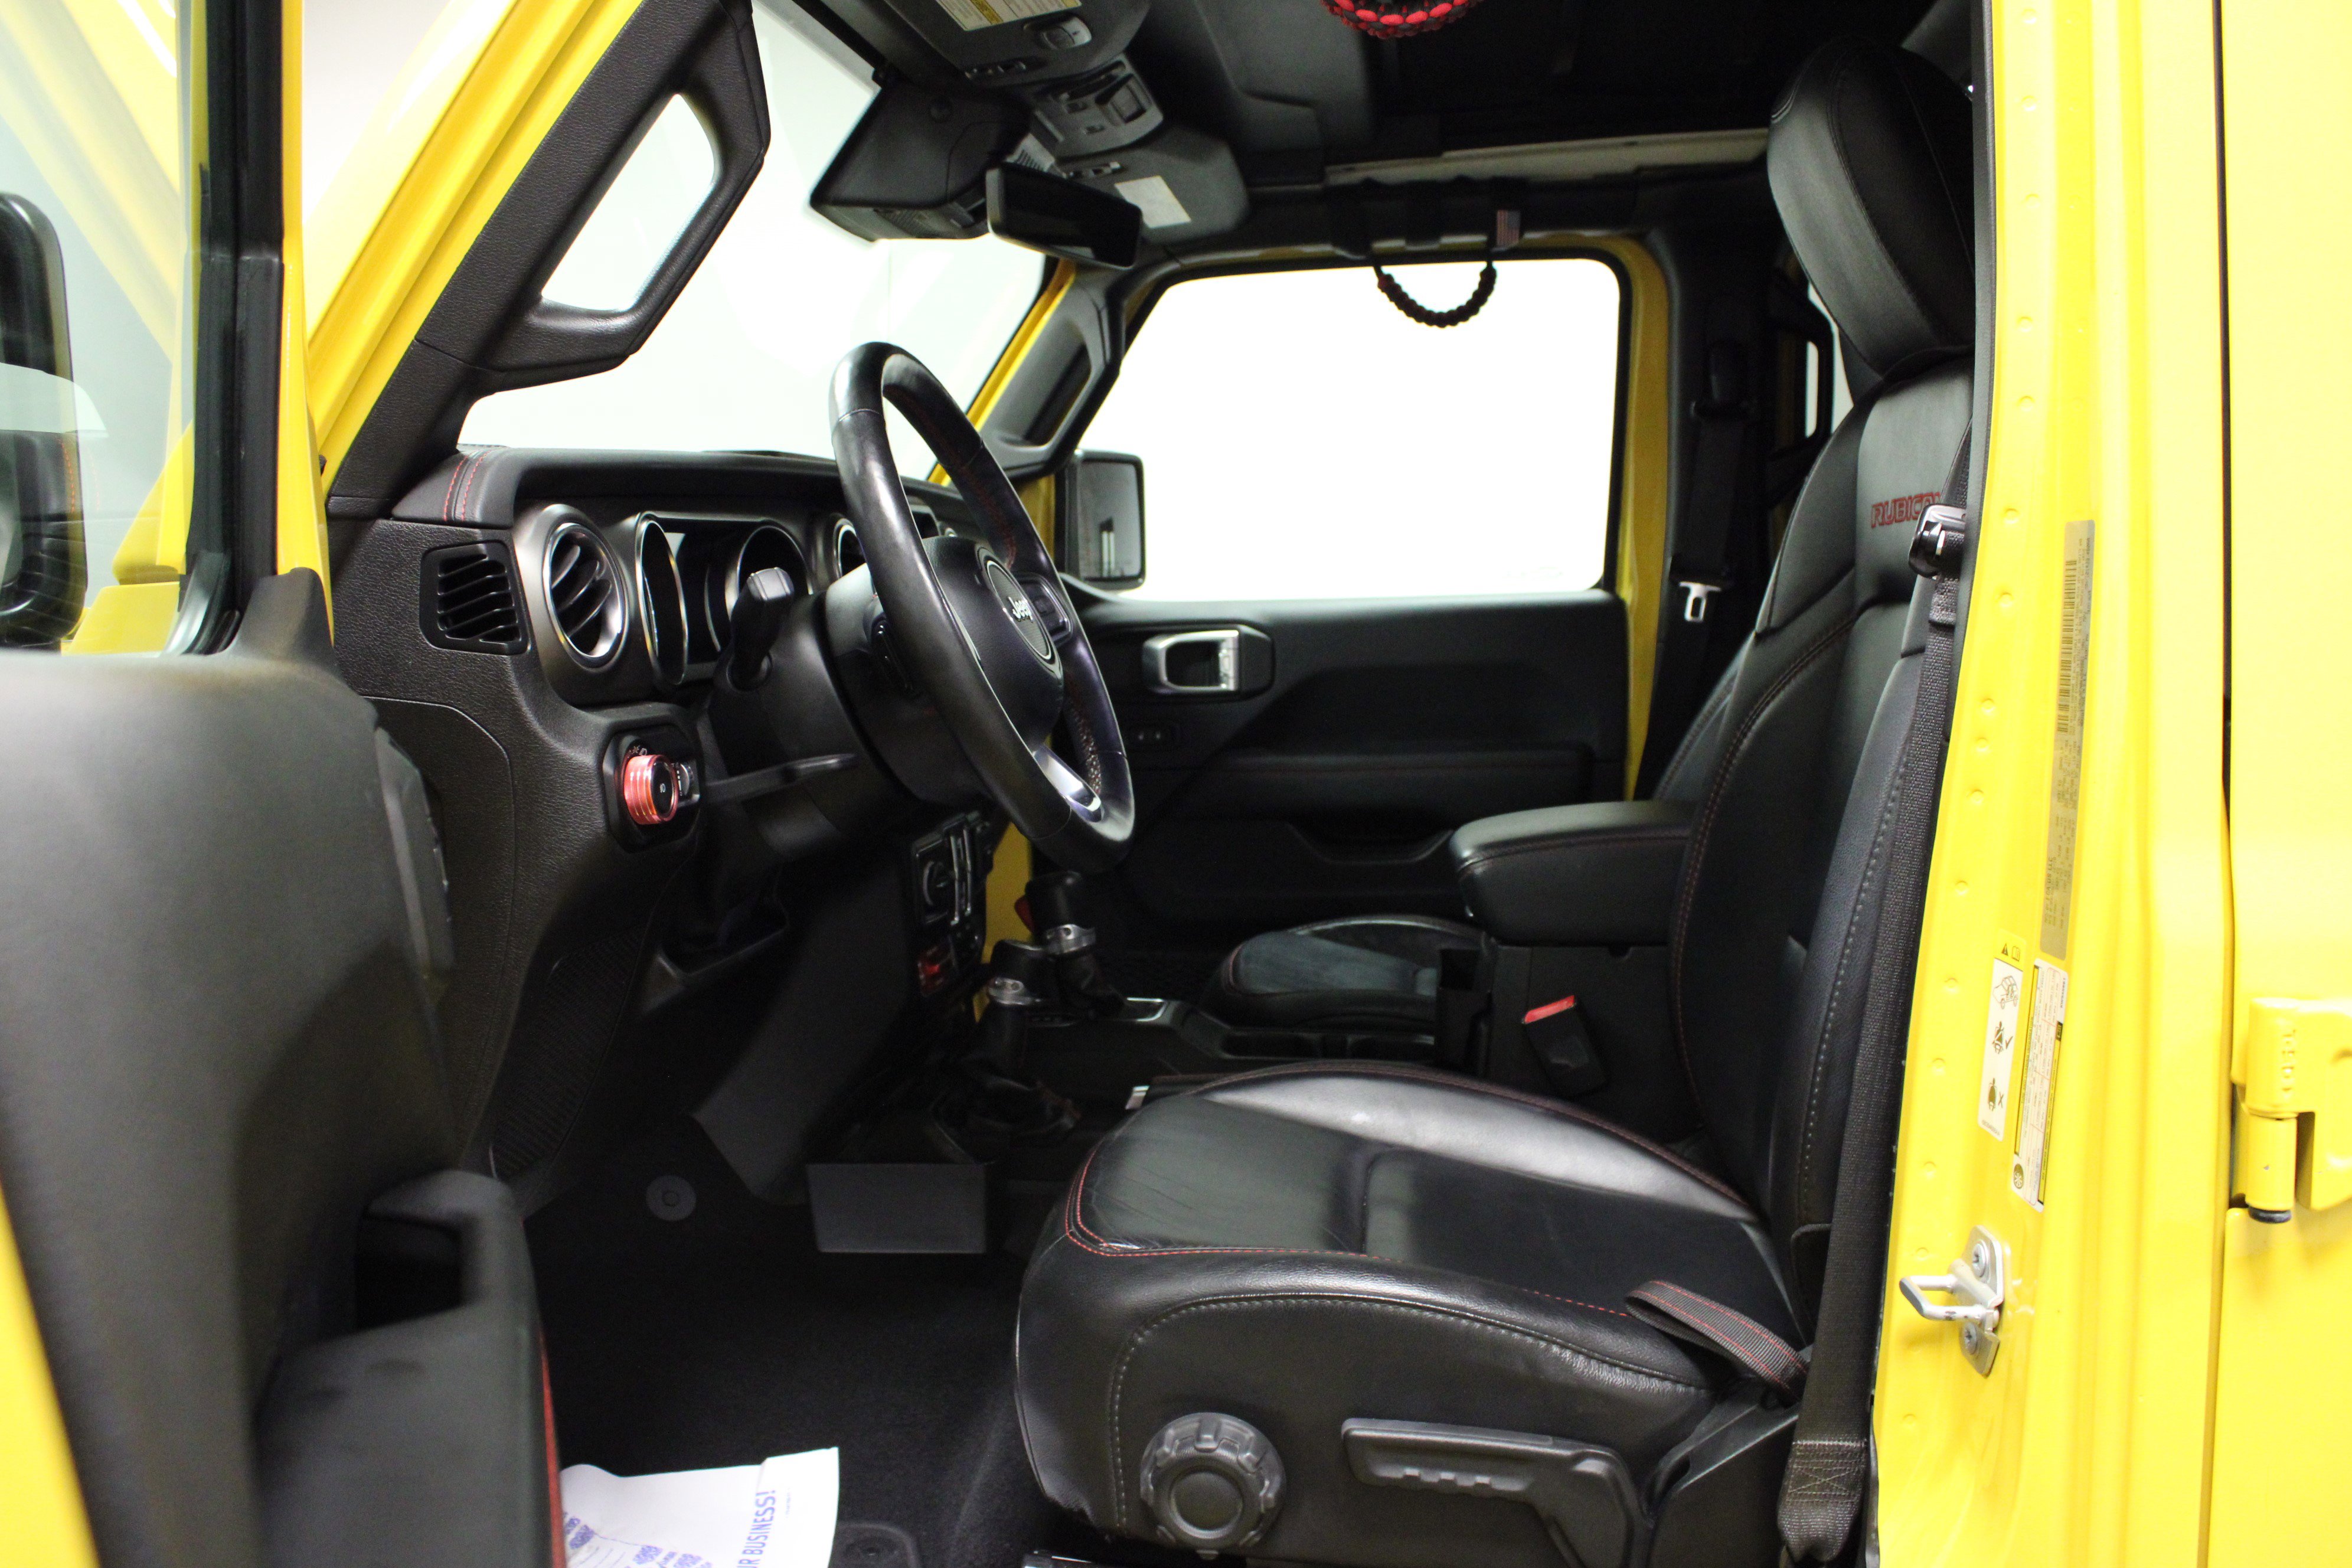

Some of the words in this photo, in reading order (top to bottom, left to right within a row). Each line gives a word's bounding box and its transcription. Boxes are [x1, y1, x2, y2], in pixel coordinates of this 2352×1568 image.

[1870, 492, 1942, 528] RUBIC
[1008, 596, 1033, 620] Jeep
[741, 1489, 776, 1555] BUSINESS!
